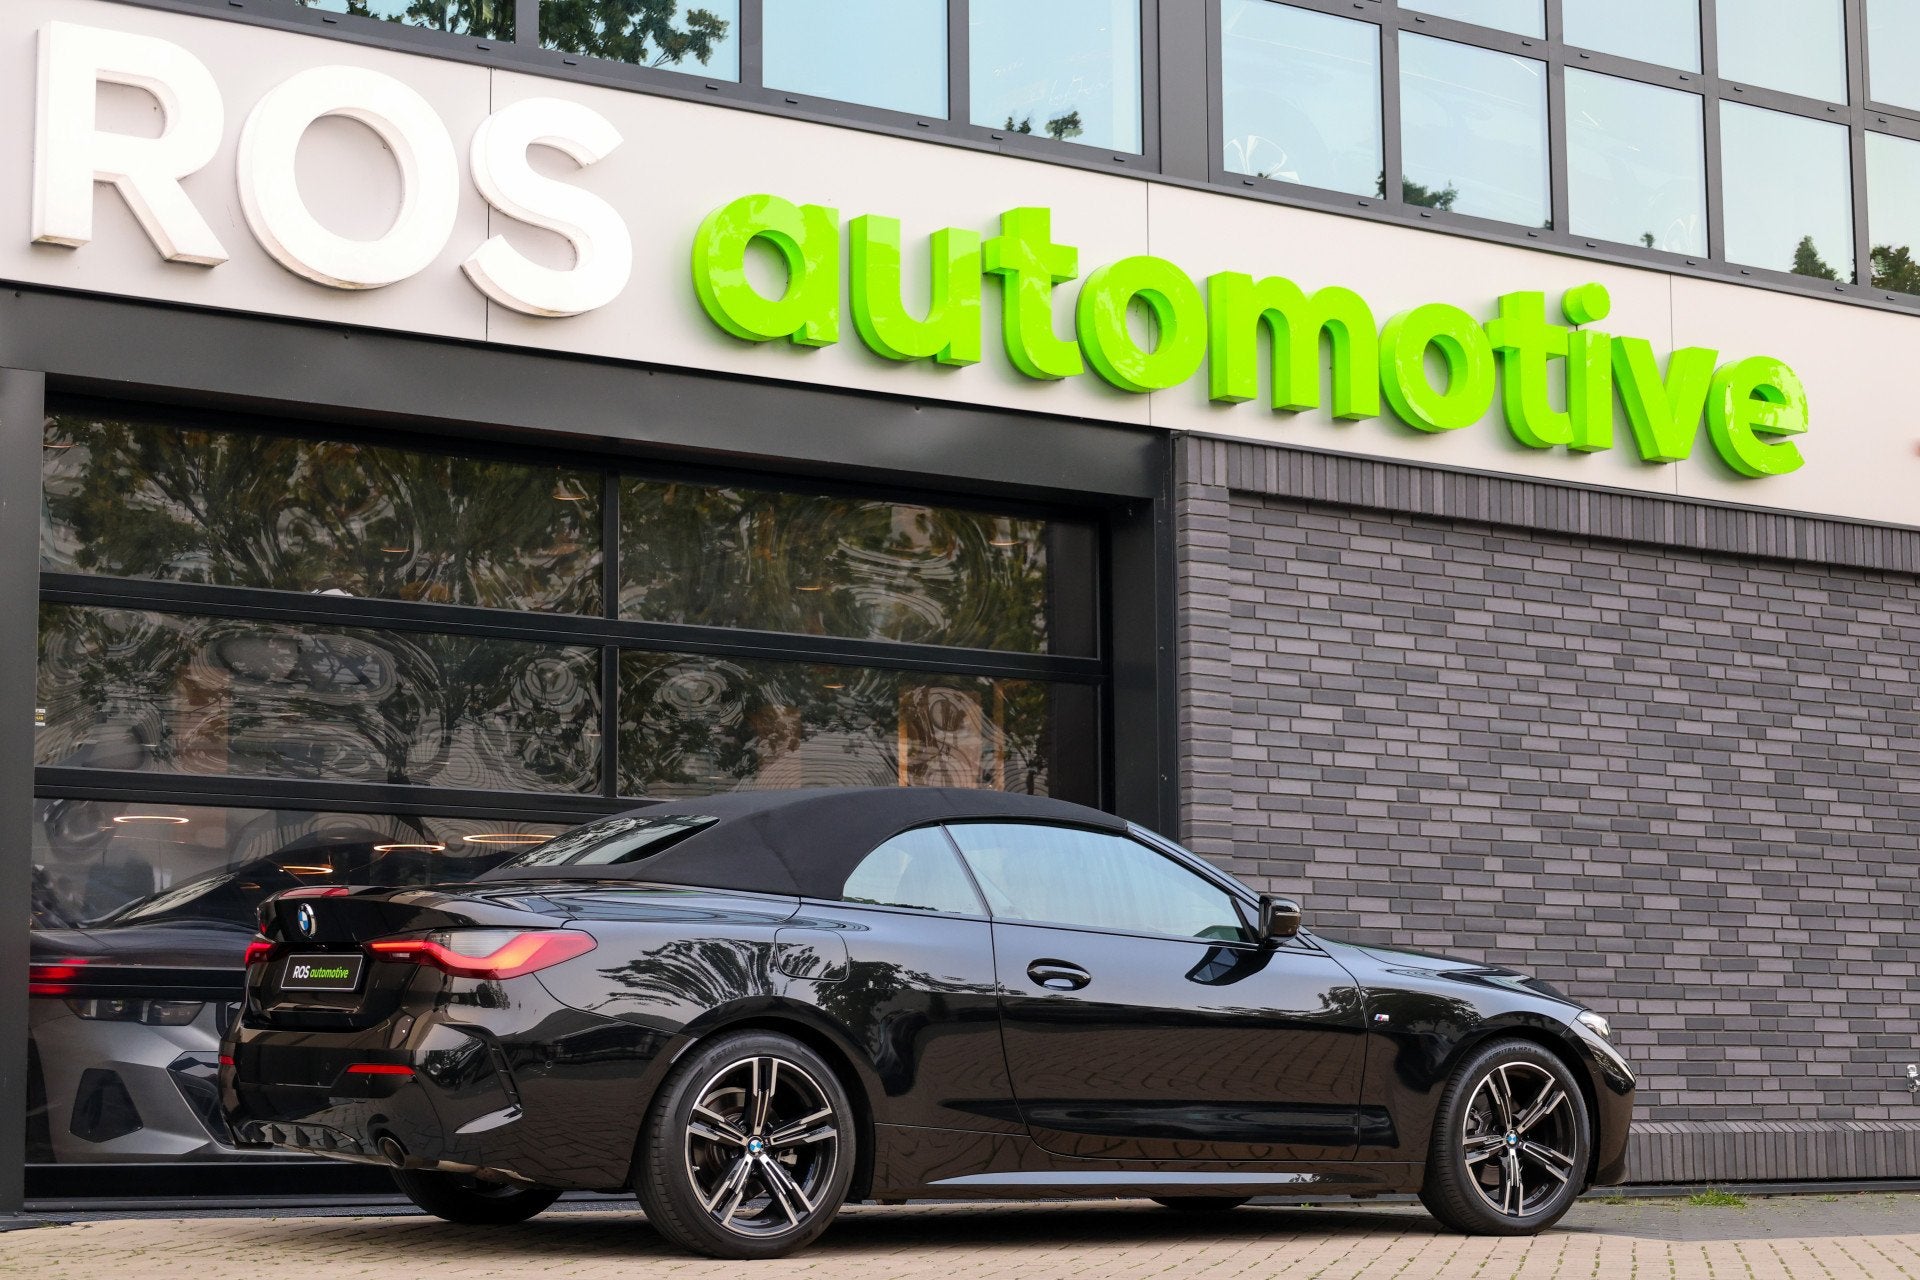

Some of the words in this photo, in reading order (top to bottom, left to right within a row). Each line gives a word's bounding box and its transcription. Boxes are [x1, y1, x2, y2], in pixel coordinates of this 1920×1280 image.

[31, 21, 632, 318] ROS
[691, 193, 1809, 479] automotive
[292, 965, 311, 979] ROS
[309, 966, 349, 979] automotive
